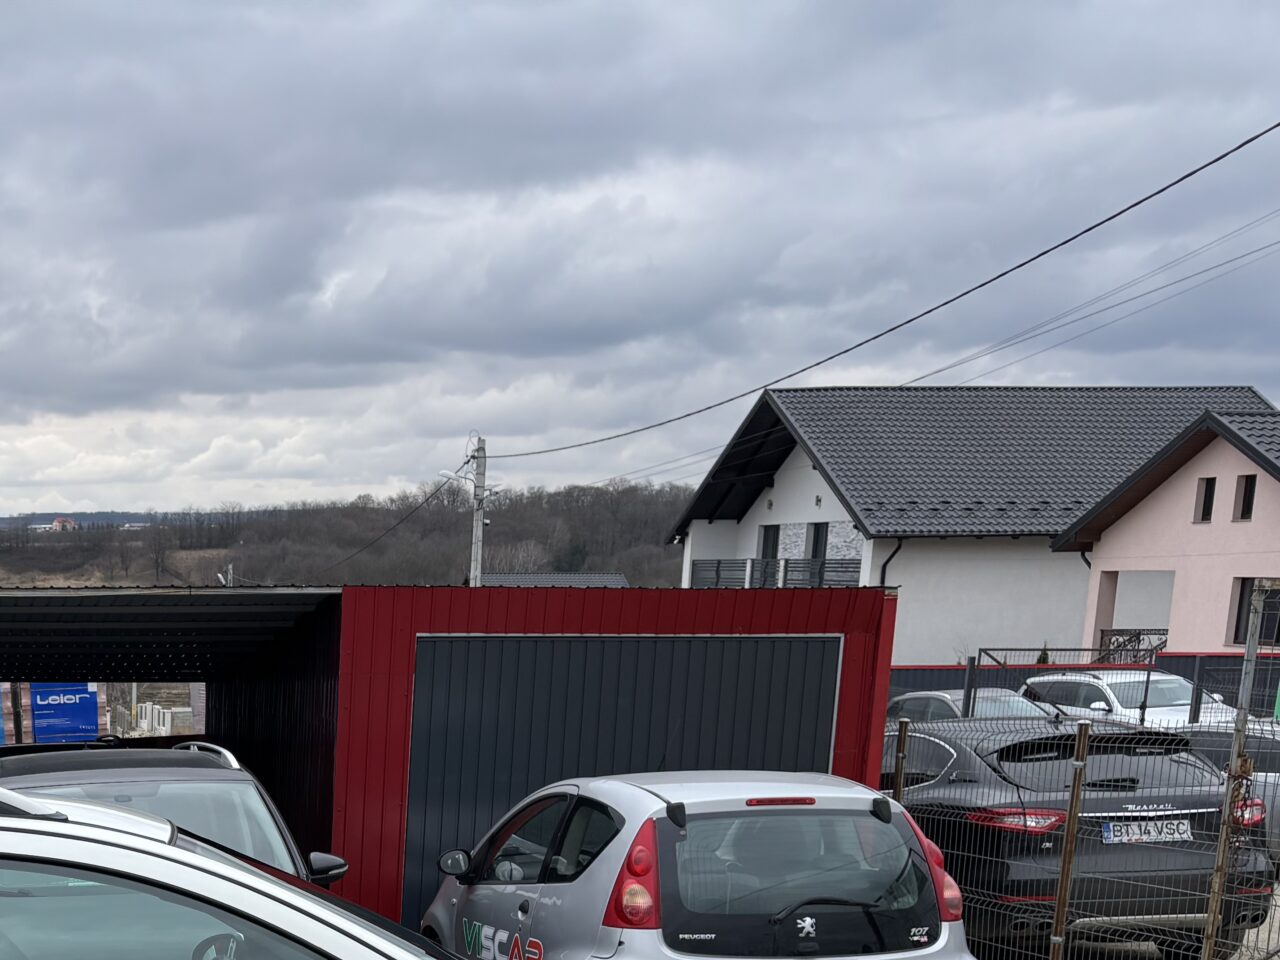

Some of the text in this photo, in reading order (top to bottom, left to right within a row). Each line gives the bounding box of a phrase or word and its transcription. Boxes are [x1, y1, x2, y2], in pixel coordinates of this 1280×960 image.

[1112, 823, 1132, 838] BT
[1154, 820, 1187, 836] VSC
[910, 926, 929, 936] 107
